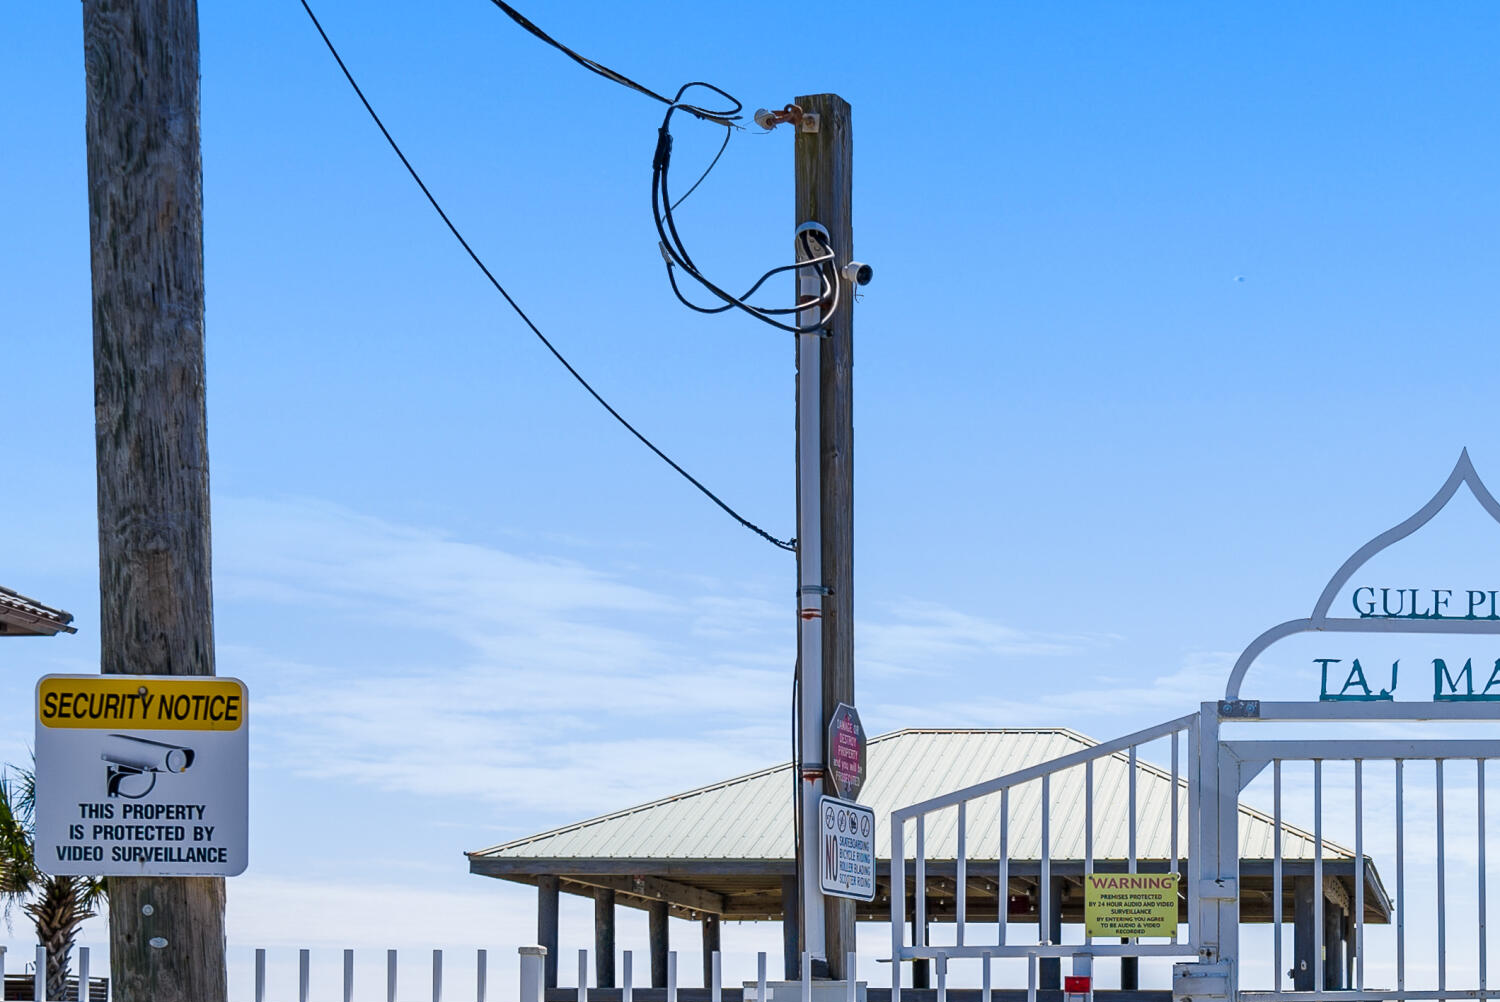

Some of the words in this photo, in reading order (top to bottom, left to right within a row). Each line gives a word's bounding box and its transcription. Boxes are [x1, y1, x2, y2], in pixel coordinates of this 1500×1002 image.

[1352, 586, 1453, 618] GULF
[1312, 658, 1400, 699] TAJ
[43, 692, 155, 720] SECURITY
[158, 695, 240, 721] NOTICE
[79, 803, 114, 819] THIS
[123, 804, 206, 820] PROPERTY
[69, 824, 84, 840] IS
[93, 825, 185, 841] PROTECTED
[193, 826, 215, 842] BY
[839, 836, 869, 851] SKATEBOARDING
[56, 846, 103, 861] VIDEO
[112, 846, 227, 863] SURVEILLANCE
[825, 833, 838, 882] NO
[839, 848, 856, 861] BICYCLE
[856, 852, 870, 864] RIDING
[839, 861, 853, 873] ROLLER
[854, 864, 871, 876] BLADING
[857, 877, 870, 888] RIDING
[1092, 877, 1172, 889] WARNING
